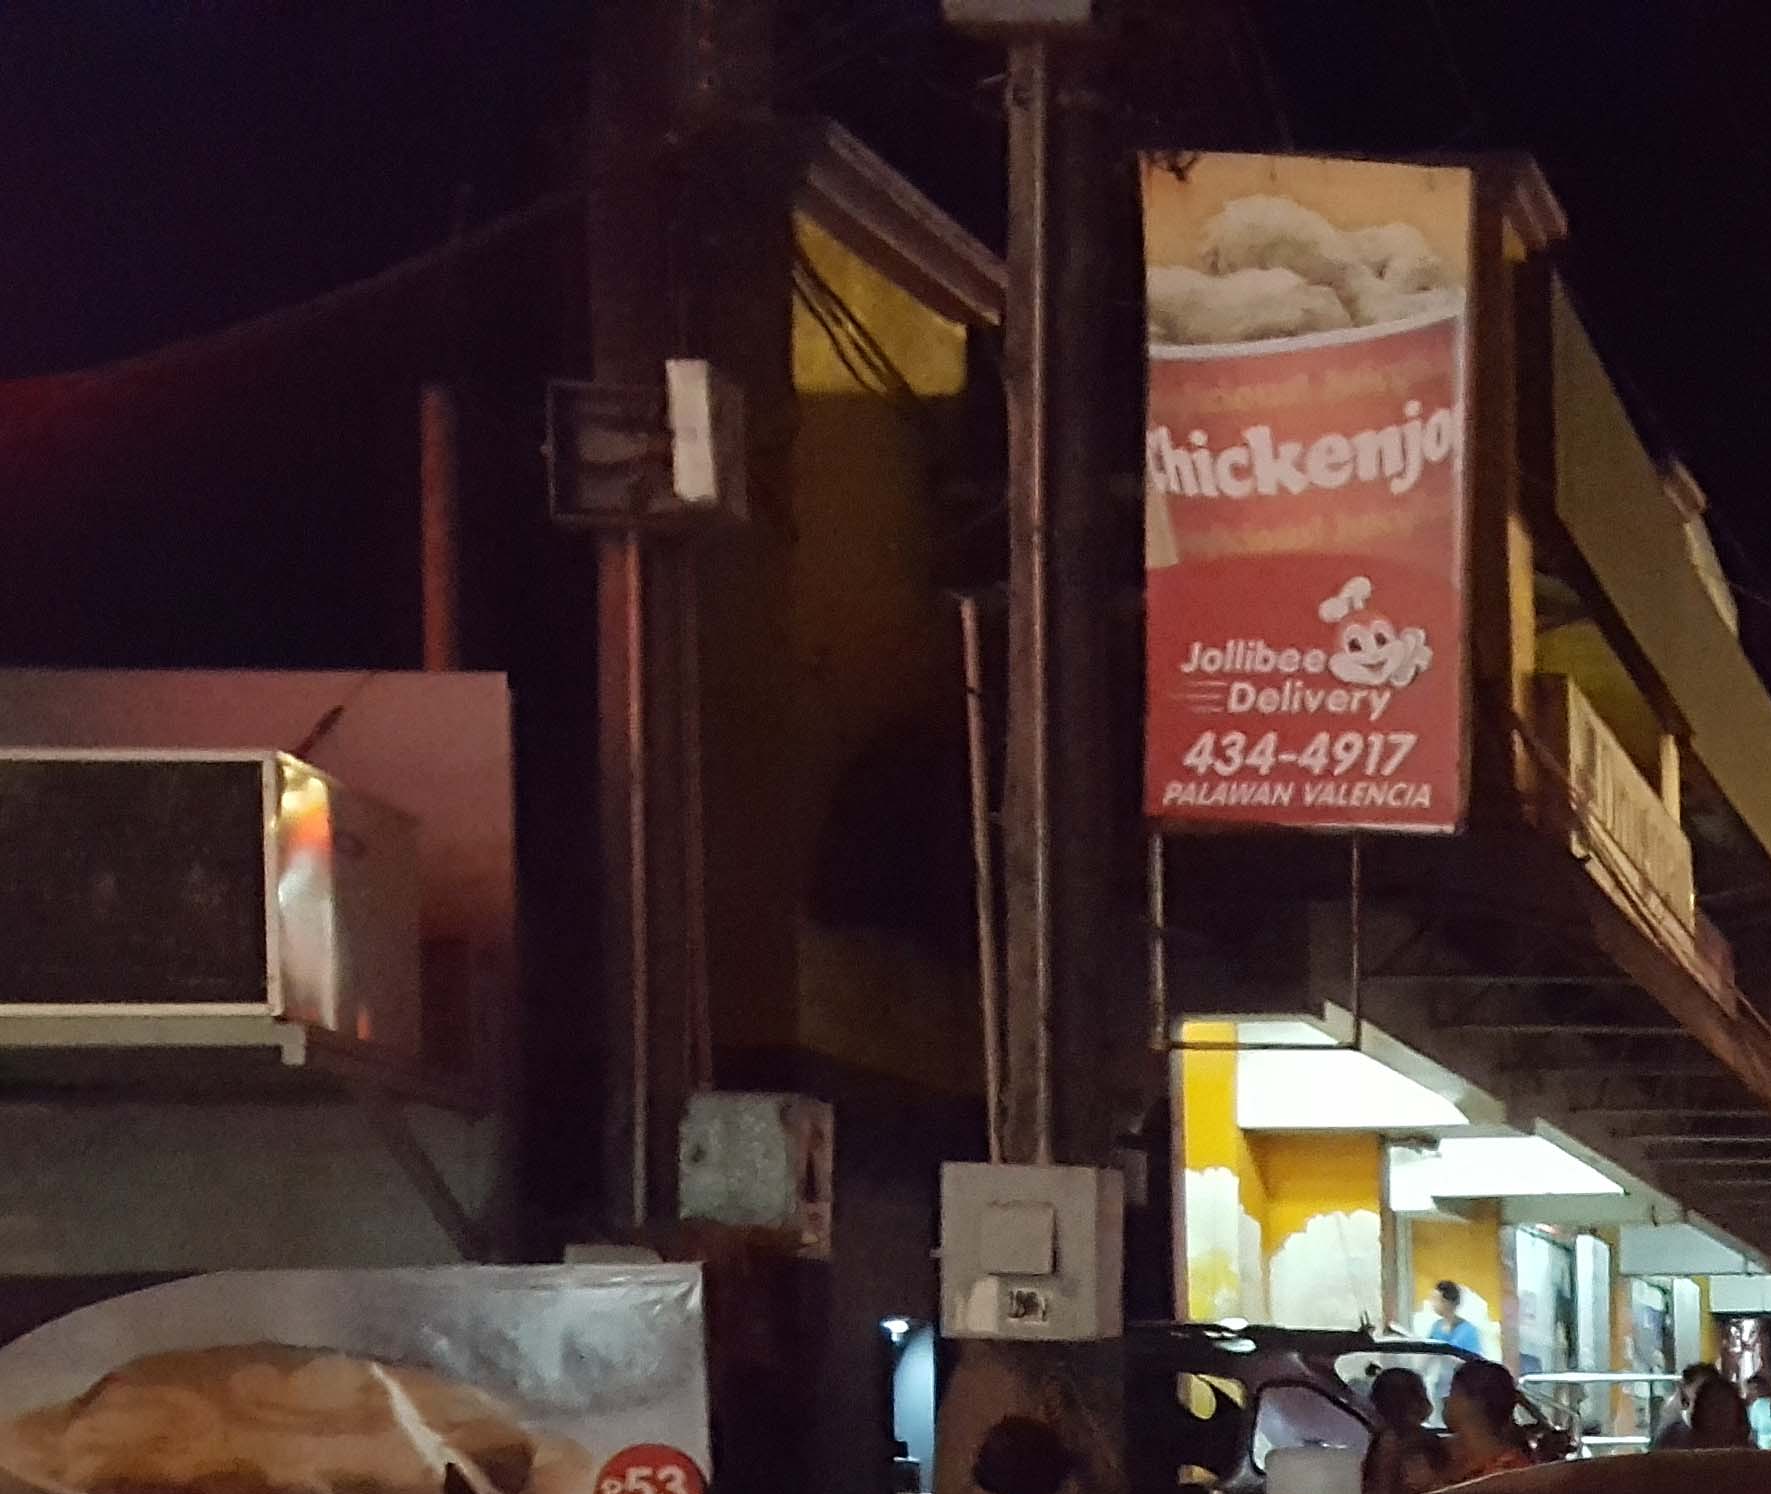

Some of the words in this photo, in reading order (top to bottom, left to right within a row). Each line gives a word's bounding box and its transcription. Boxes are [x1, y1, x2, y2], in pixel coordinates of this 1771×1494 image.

[1181, 638, 1327, 673] Jollibee
[1227, 678, 1391, 721] Delivery
[1182, 730, 1418, 777] 434-4917
[1161, 779, 1295, 807] PALAWAN
[1302, 781, 1432, 808] VALENCIA
